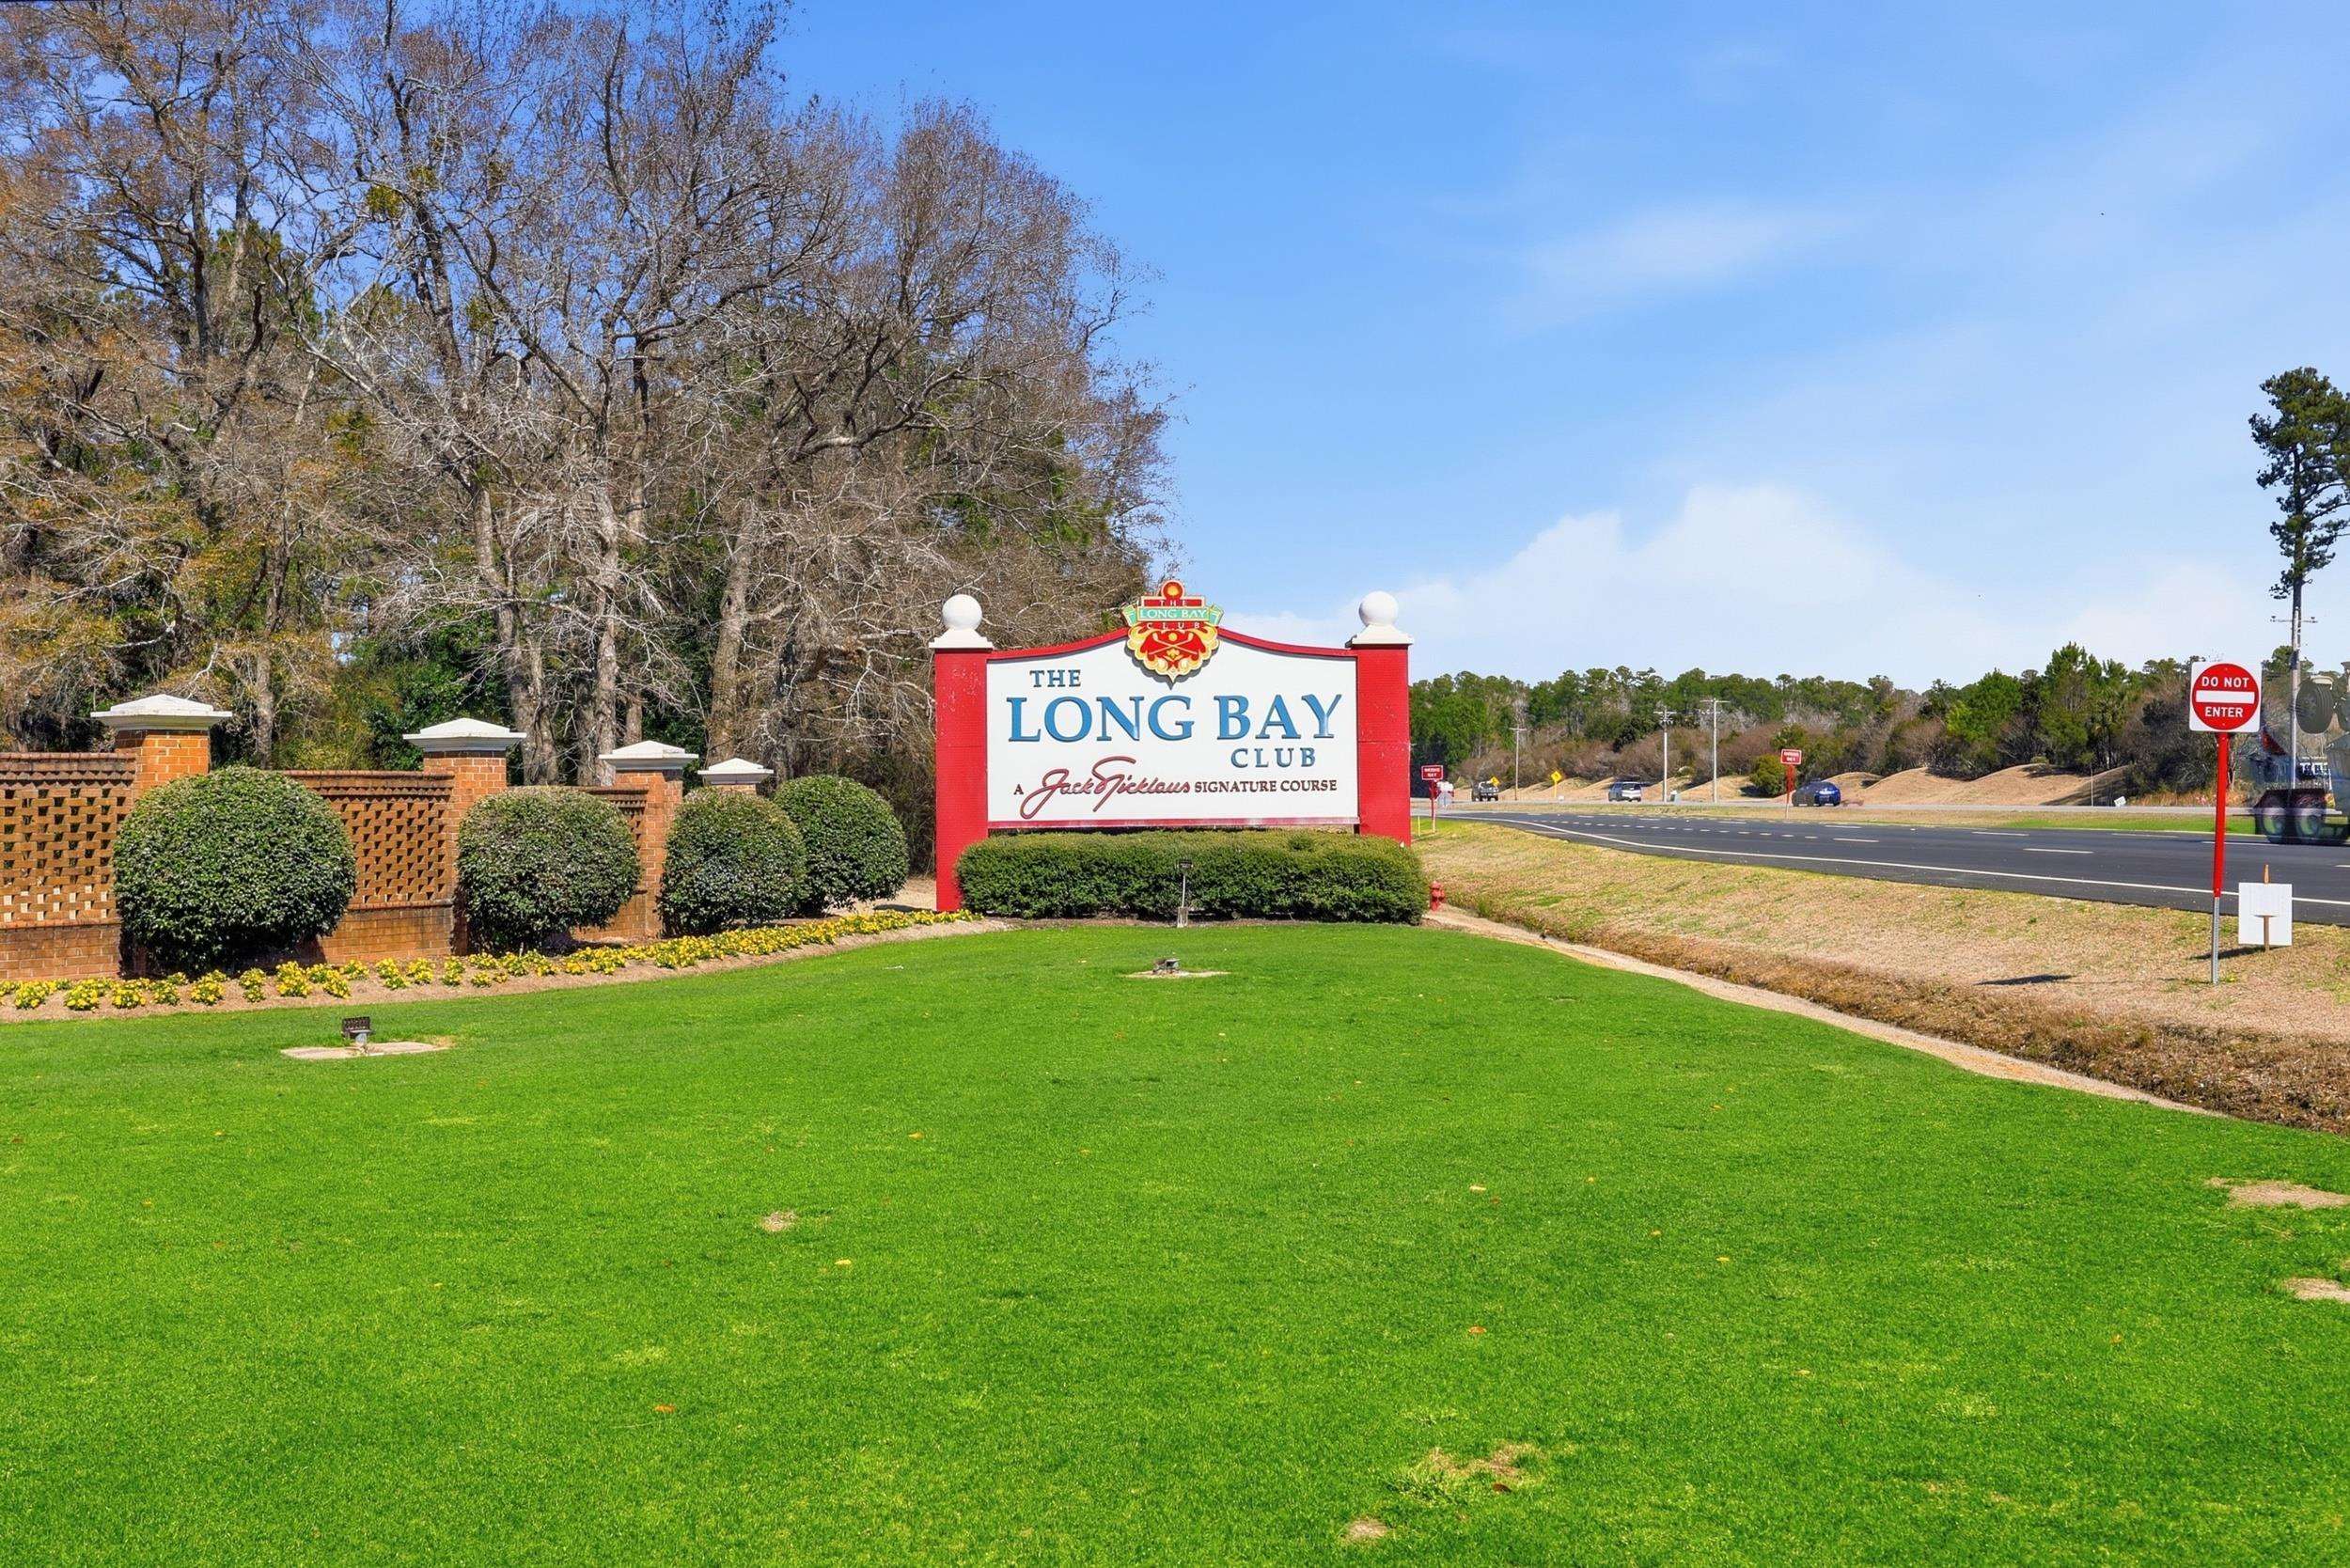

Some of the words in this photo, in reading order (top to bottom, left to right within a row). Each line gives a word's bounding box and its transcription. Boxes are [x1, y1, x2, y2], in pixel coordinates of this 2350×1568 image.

[1140, 609, 1177, 619] LONG
[1181, 609, 1207, 619] BAY
[1029, 669, 1081, 688] THE
[2201, 676, 2218, 687] DO
[2224, 677, 2249, 688] NOT
[1006, 695, 1195, 743] LONG
[1214, 694, 1342, 741] BAY
[2204, 706, 2244, 718] ENTER
[1230, 747, 1316, 768] CLUB
[1013, 783, 1024, 795] A
[1020, 768, 1093, 820] Jack
[1194, 780, 1277, 793] SIGNATURE
[1280, 779, 1338, 792] COURSE
